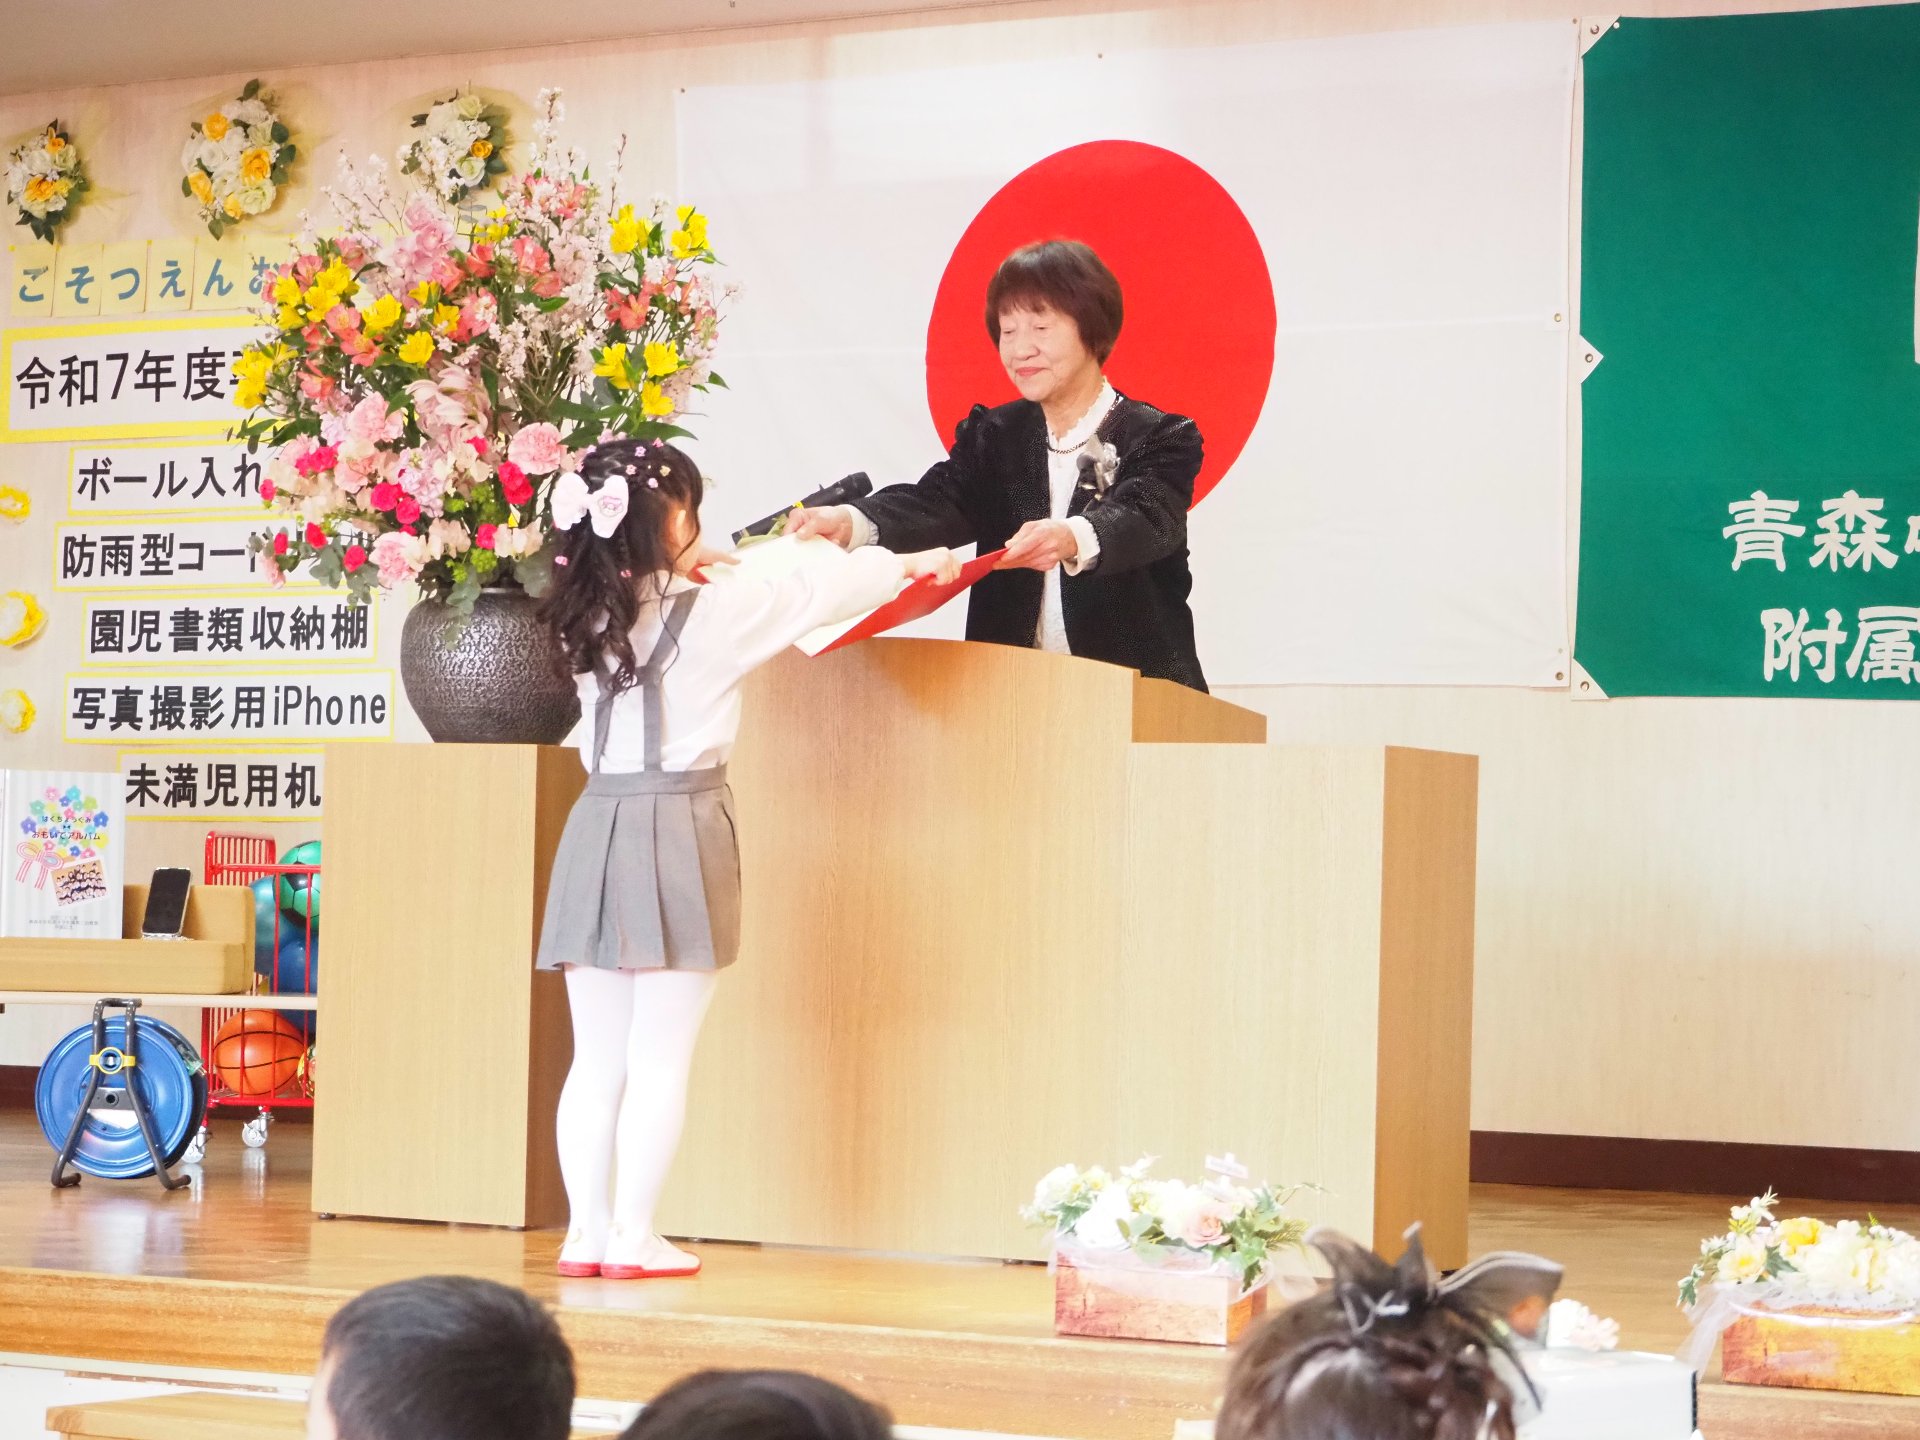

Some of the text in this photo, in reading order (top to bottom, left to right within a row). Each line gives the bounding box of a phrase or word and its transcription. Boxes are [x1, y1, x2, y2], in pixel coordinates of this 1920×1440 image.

[16, 347, 242, 410] 令和7年度
[1723, 490, 1920, 573] 青森
[90, 604, 368, 653] 園児書類収納棚
[1760, 606, 1920, 684] 附属
[72, 685, 386, 732] 写真撮影用iPhone
[125, 762, 321, 809] 未満児用机
[31, 831, 101, 840] おもいでアルバム
